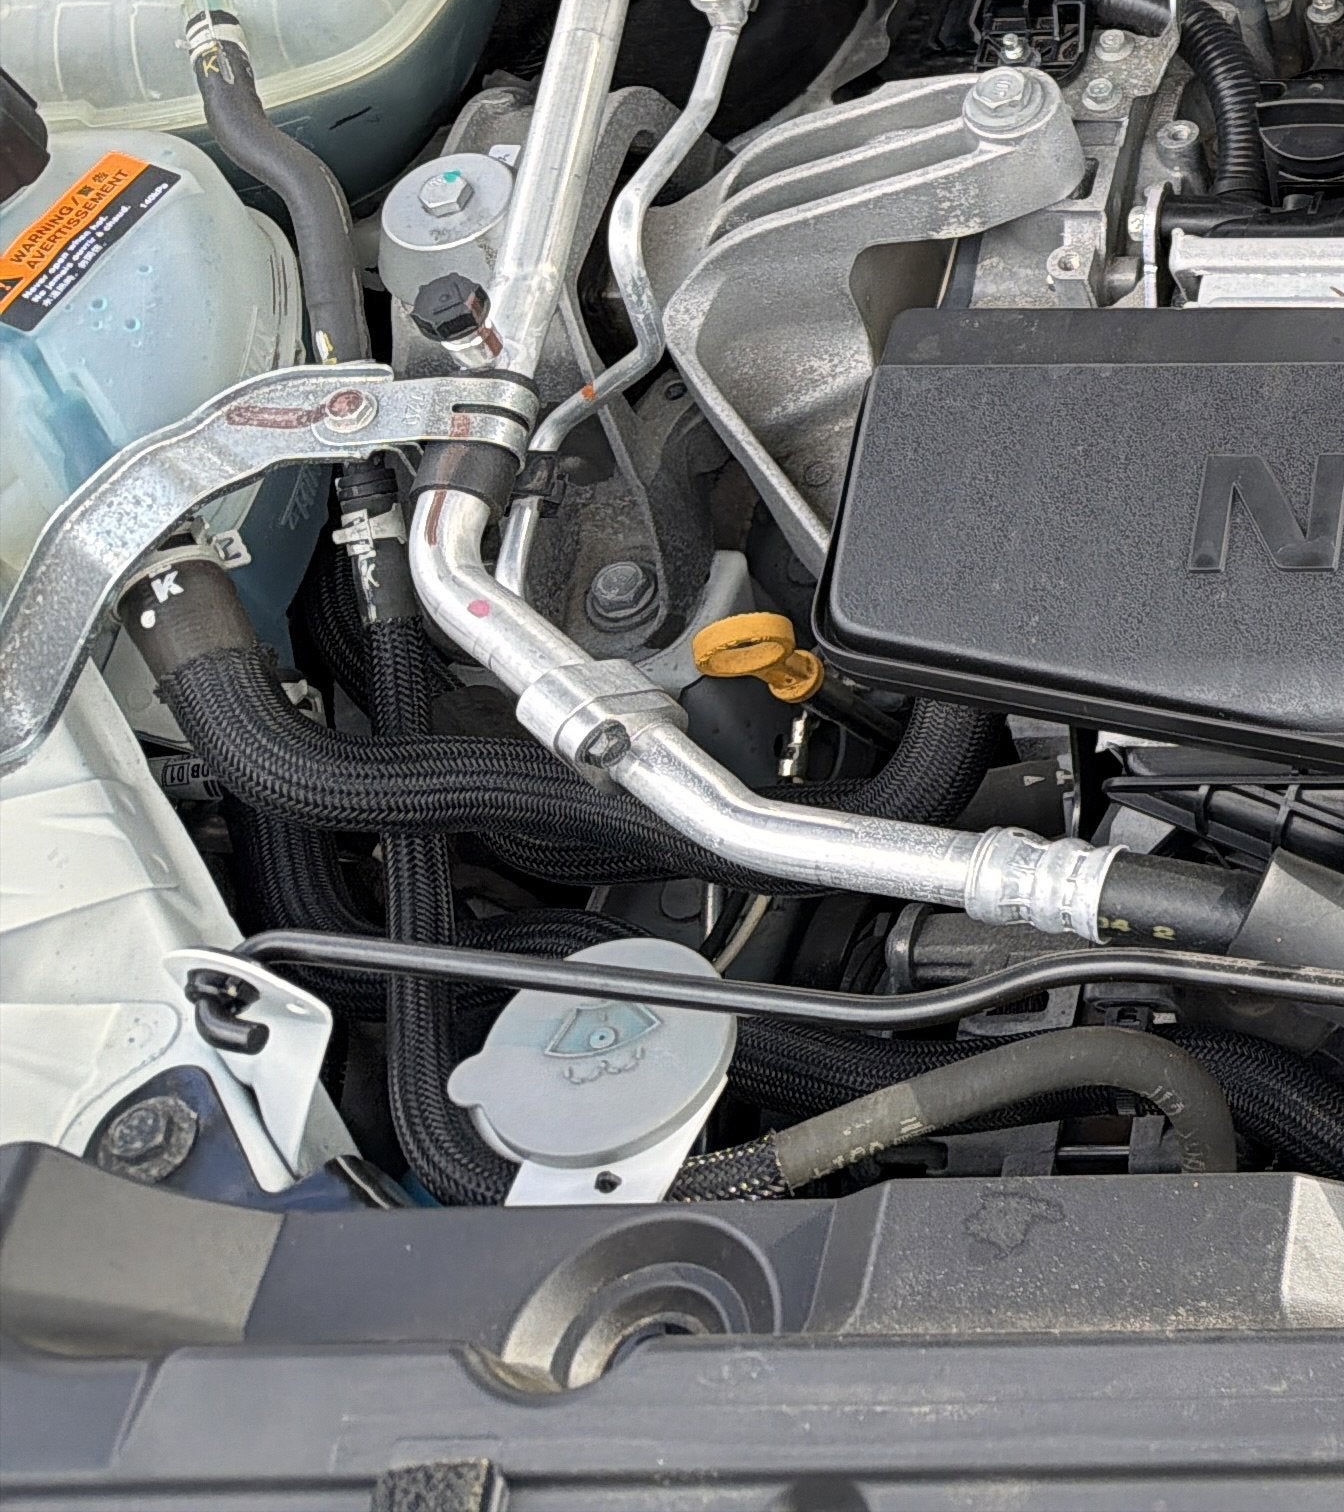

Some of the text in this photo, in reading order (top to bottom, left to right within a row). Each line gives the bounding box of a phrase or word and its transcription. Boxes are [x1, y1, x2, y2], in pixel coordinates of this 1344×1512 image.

[9, 206, 74, 263] WARNING
[26, 169, 129, 270] AVERTISSEMENT
[21, 216, 108, 299] Never open when hot.
[151, 571, 184, 603] K
